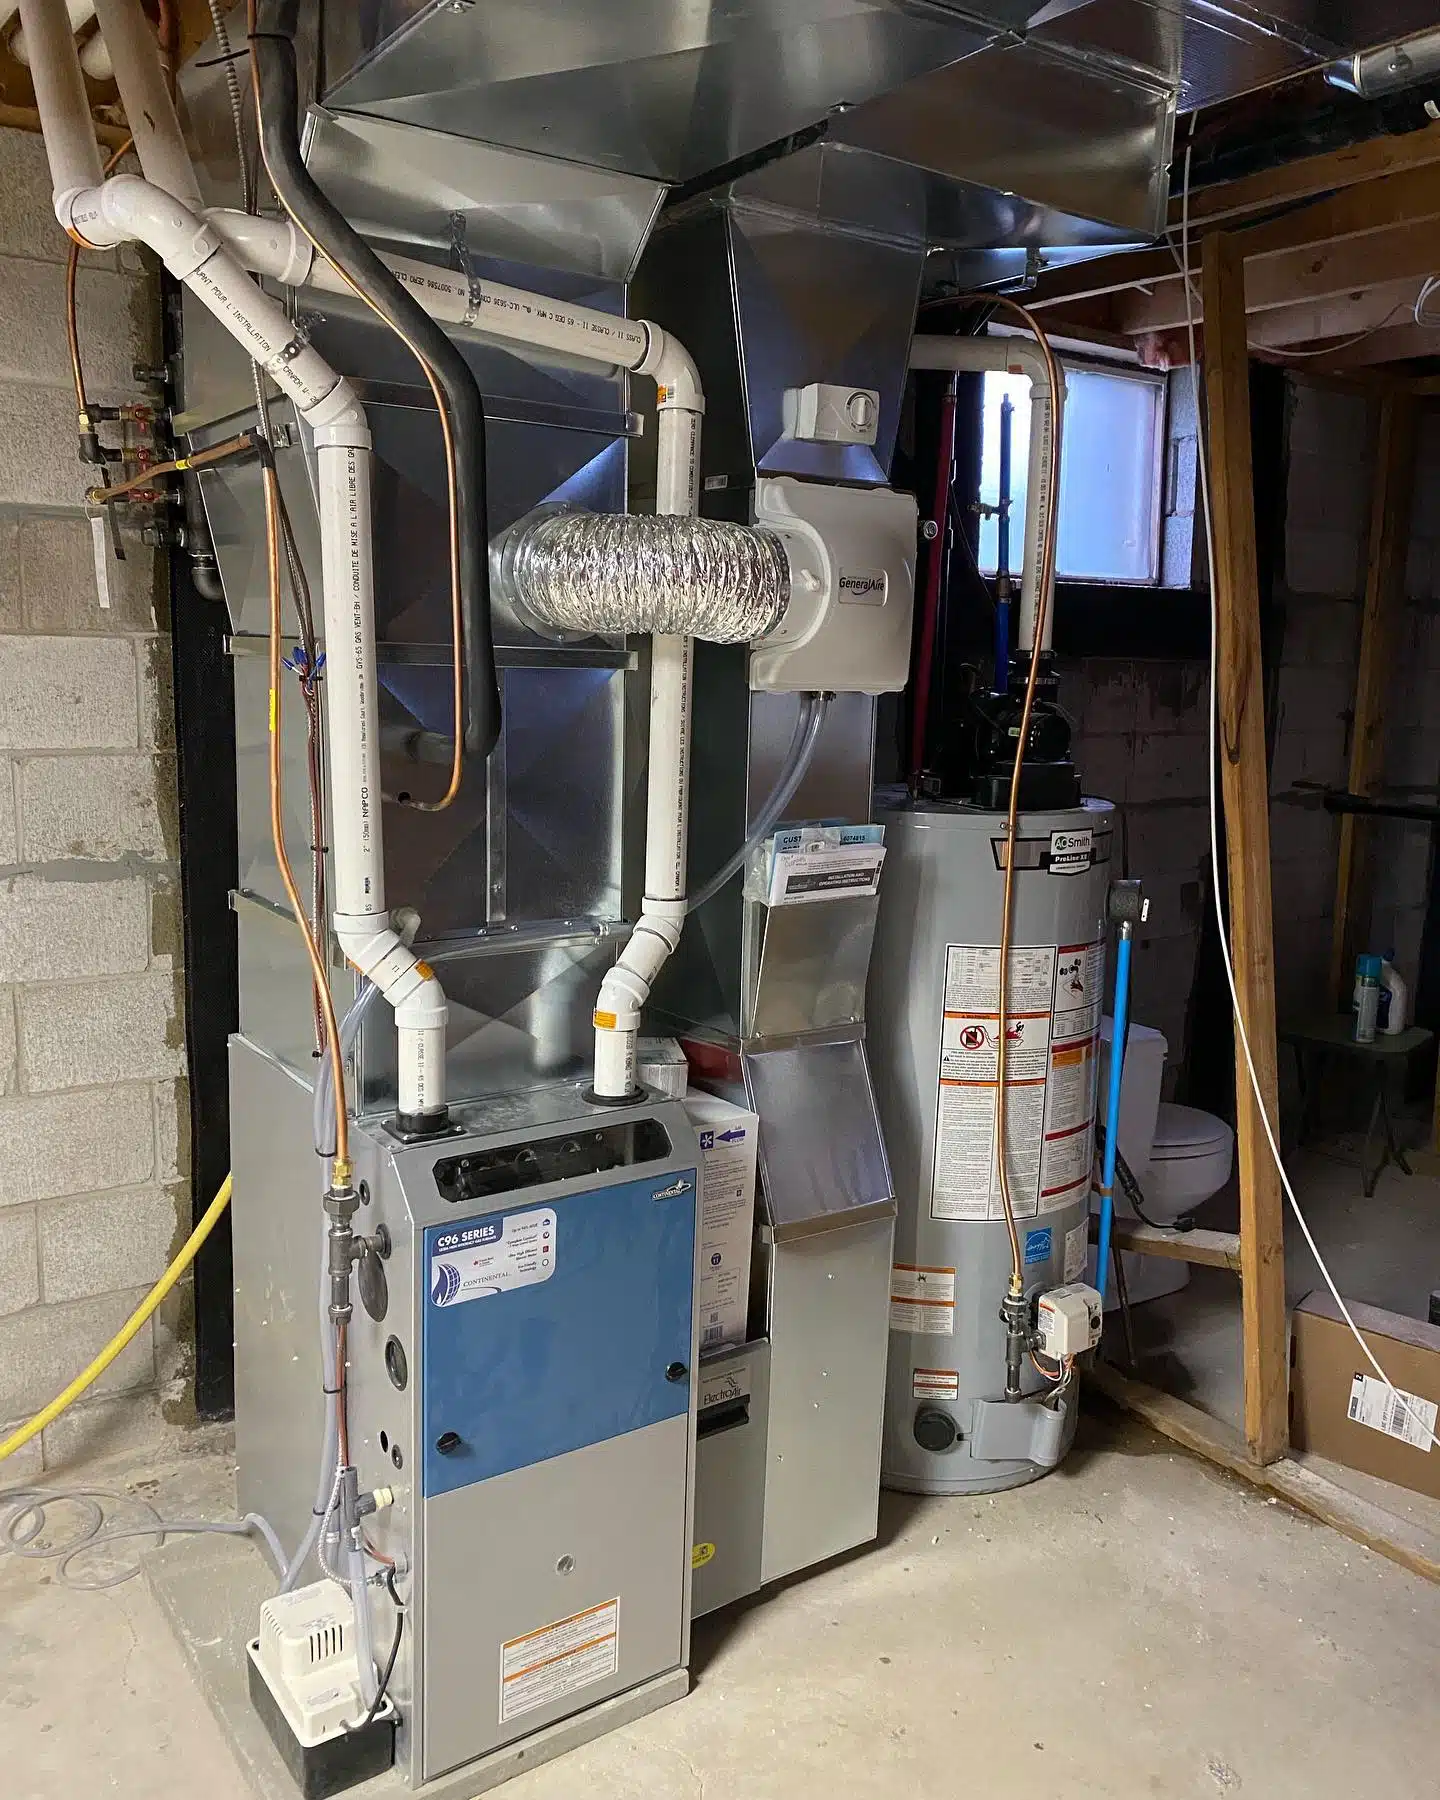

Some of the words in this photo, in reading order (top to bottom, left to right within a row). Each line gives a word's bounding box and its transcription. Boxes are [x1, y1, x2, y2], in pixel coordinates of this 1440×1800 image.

[409, 275, 424, 285] ZERO
[547, 312, 553, 320] C
[554, 313, 565, 323] DEG
[566, 317, 574, 325] 65
[590, 323, 610, 334] CLASSE
[210, 285, 227, 303] POUR
[281, 365, 303, 388] CANADA
[625, 332, 641, 343] CLASS
[352, 548, 359, 558] DE
[352, 560, 360, 591] CONDUITE
[839, 576, 885, 591] GeneralAire
[361, 786, 369, 817] NAPCO
[437, 1235, 459, 1247] C96
[462, 1226, 495, 1241] SERIES
[463, 1272, 510, 1287] CONTINENTAL
[703, 1387, 742, 1406] ElectroAir
